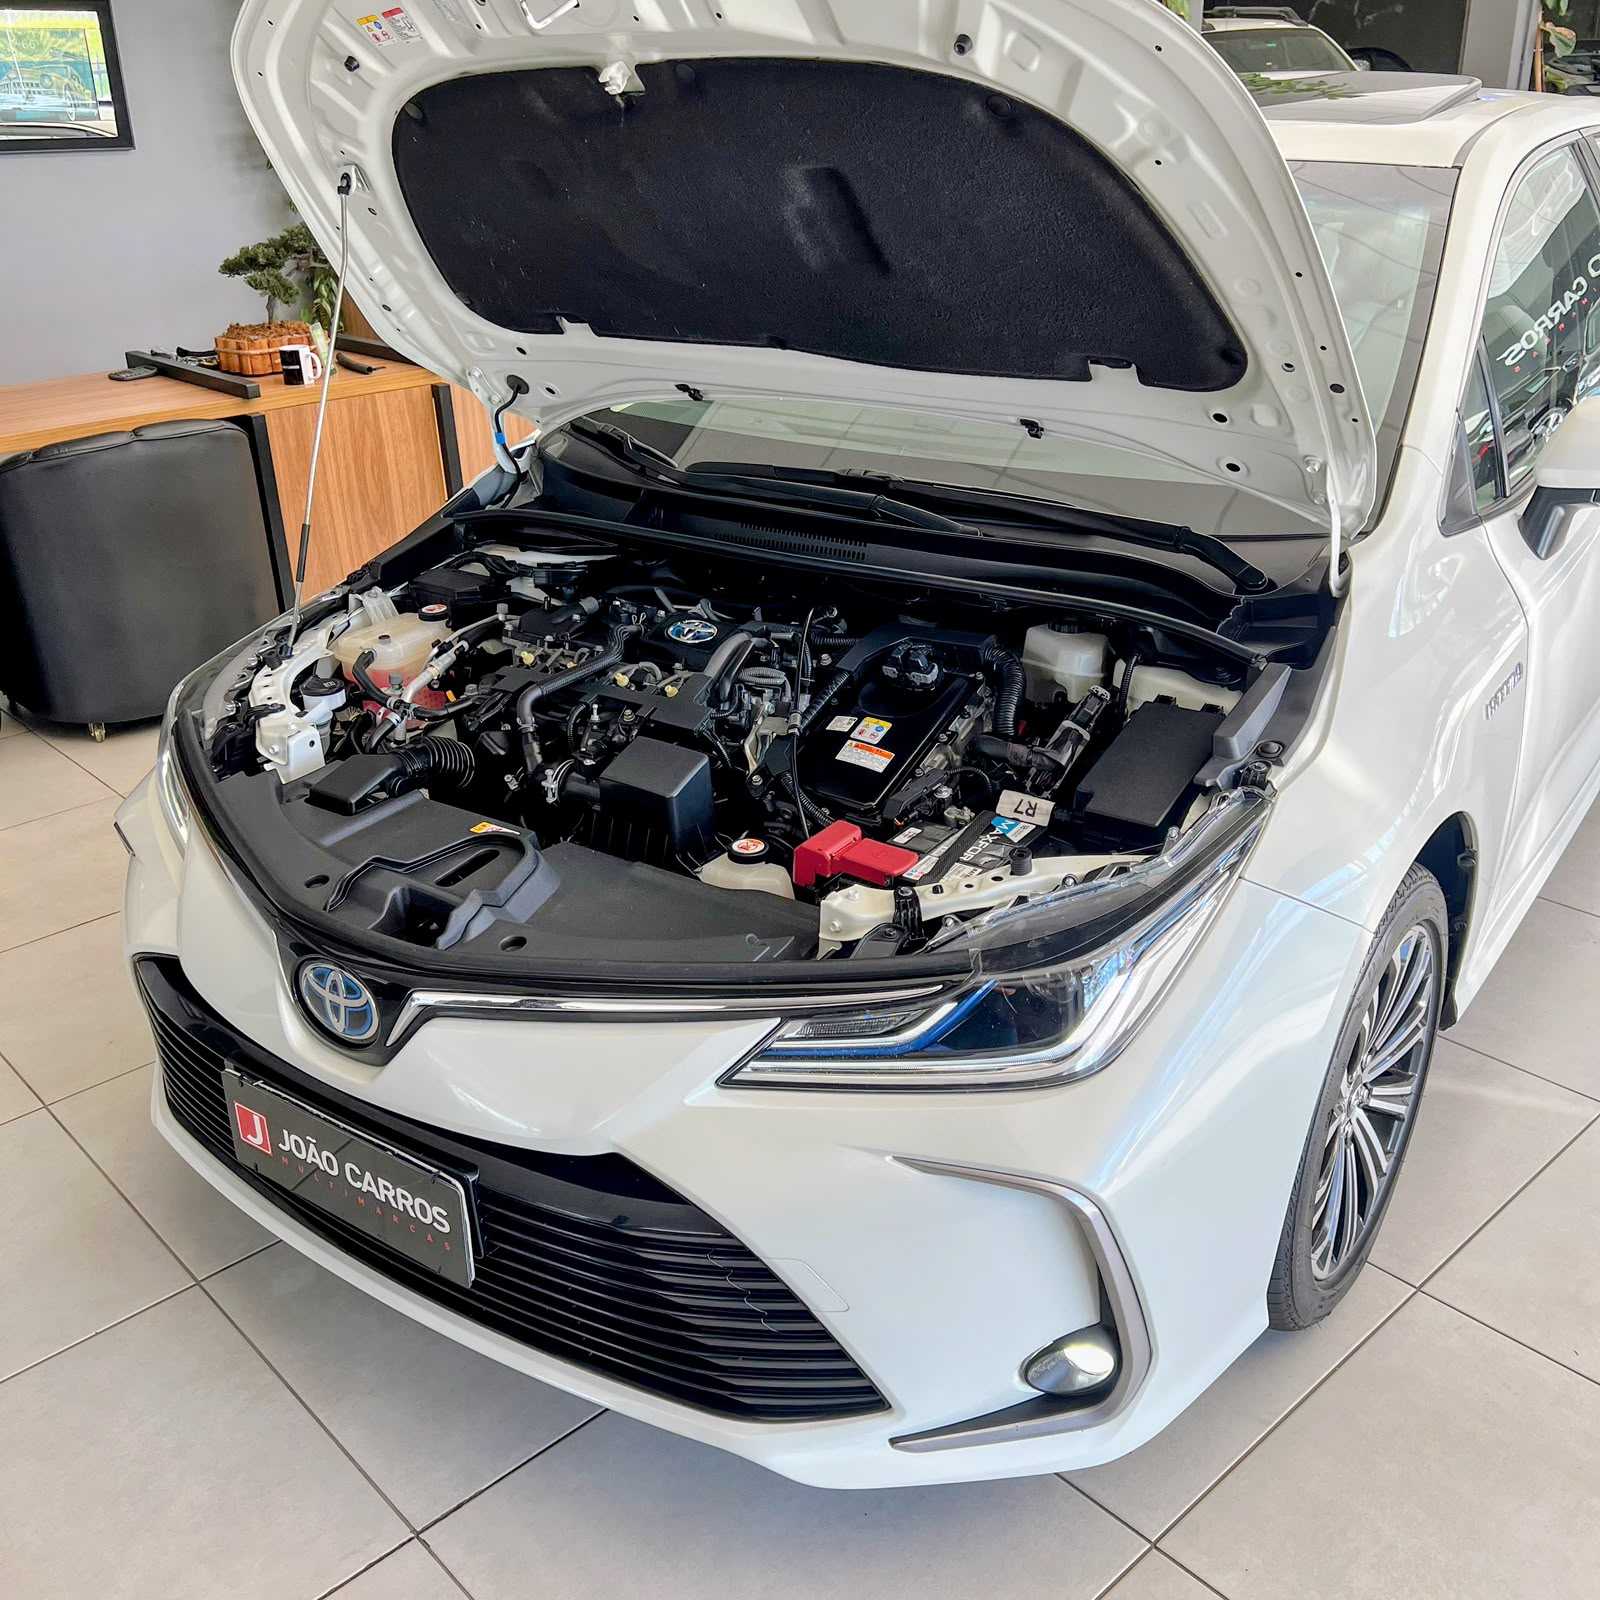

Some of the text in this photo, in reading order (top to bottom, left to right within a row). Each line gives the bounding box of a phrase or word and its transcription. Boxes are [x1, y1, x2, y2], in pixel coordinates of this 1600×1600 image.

[1013, 798, 1038, 818] R7
[246, 1114, 264, 1146] J
[278, 1128, 451, 1234] JOÃO CARROS
